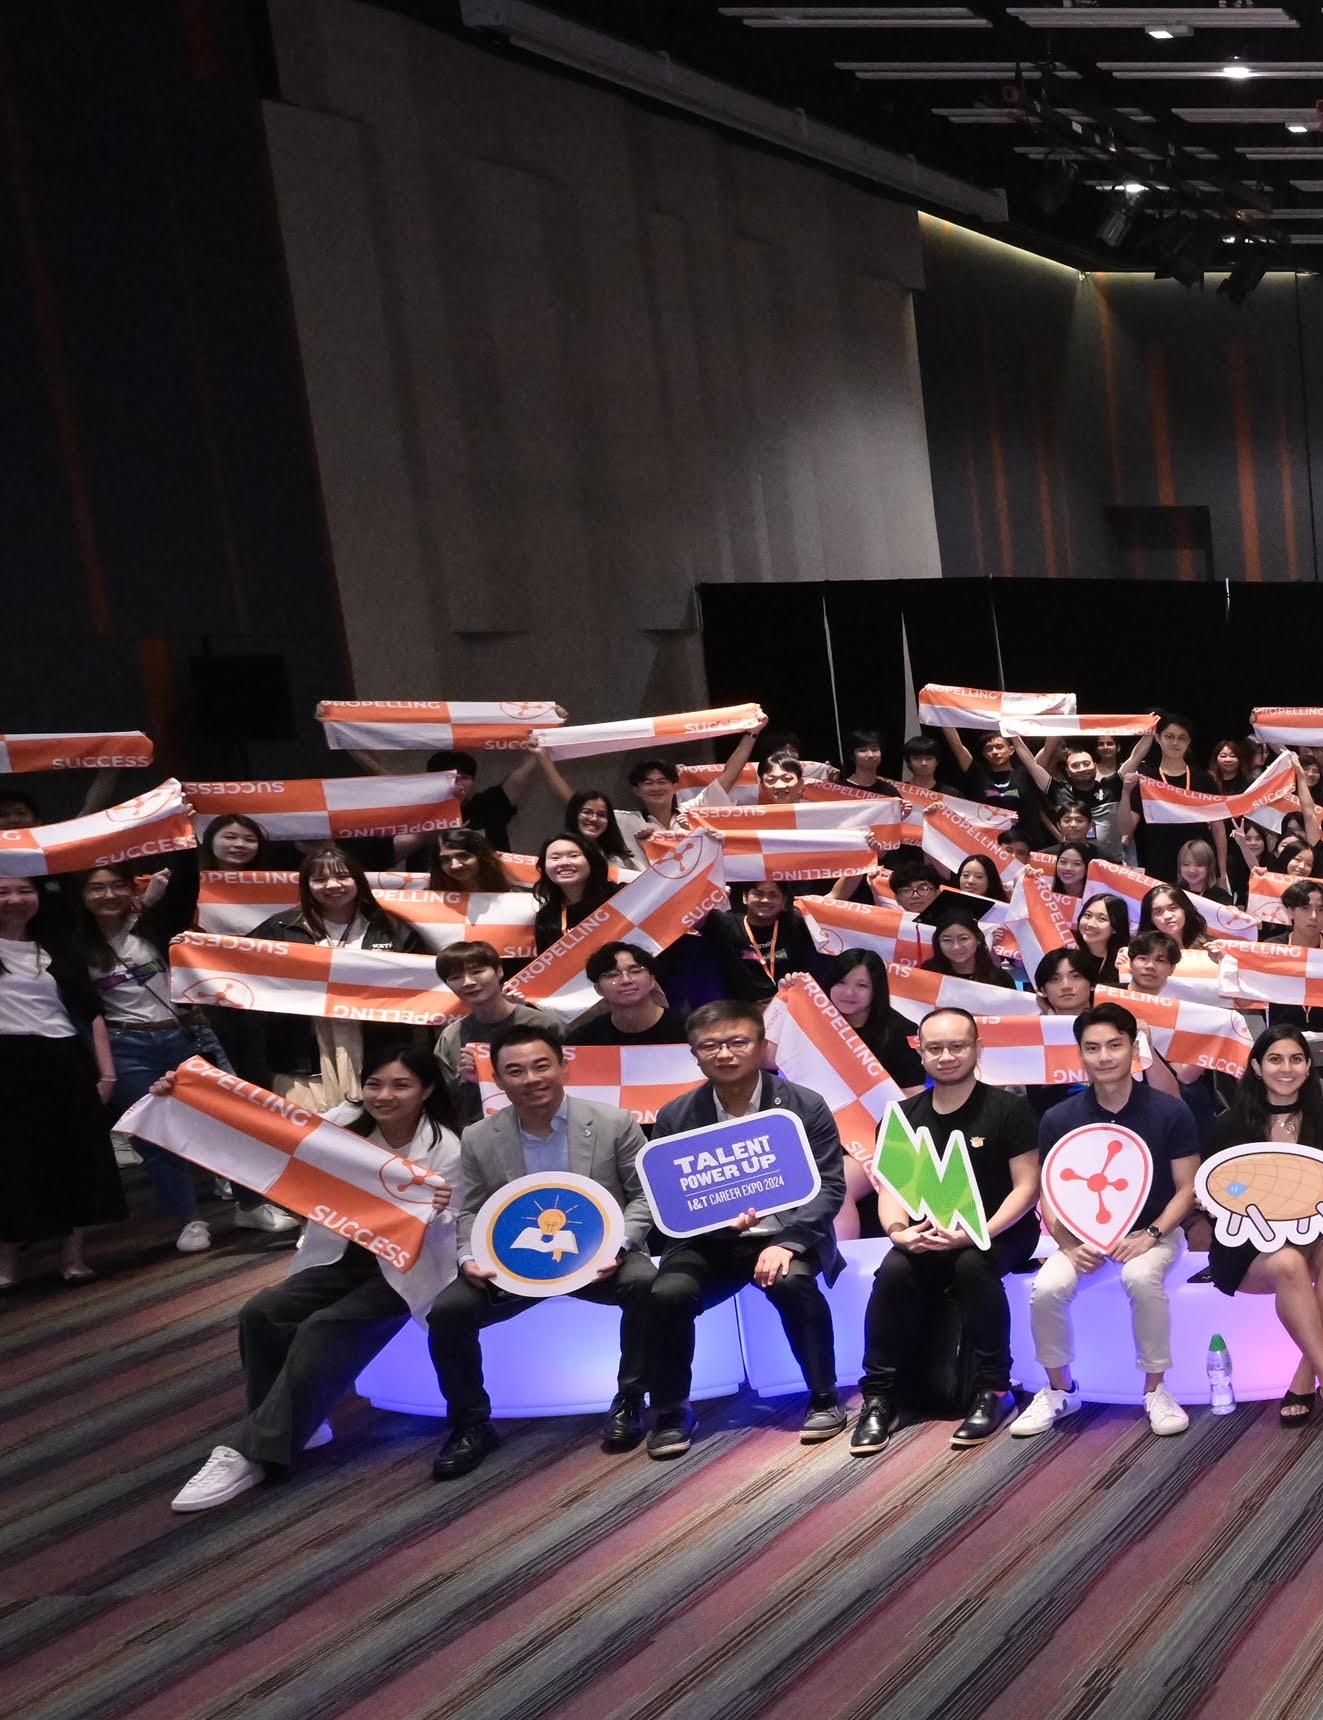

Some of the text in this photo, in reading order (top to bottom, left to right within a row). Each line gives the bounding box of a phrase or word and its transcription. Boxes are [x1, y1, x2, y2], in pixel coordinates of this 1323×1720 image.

[52, 756, 151, 770] SUCCESS
[186, 781, 285, 794] SUCCESS
[938, 803, 1009, 861] PROPELLING
[506, 909, 611, 991] PROPELLING
[672, 1135, 771, 1174] TALENT
[679, 1154, 777, 1192] POWER UP
[687, 1174, 785, 1212] I&T CAREER EXPO 2024
[307, 1204, 412, 1268] SUCCESS
